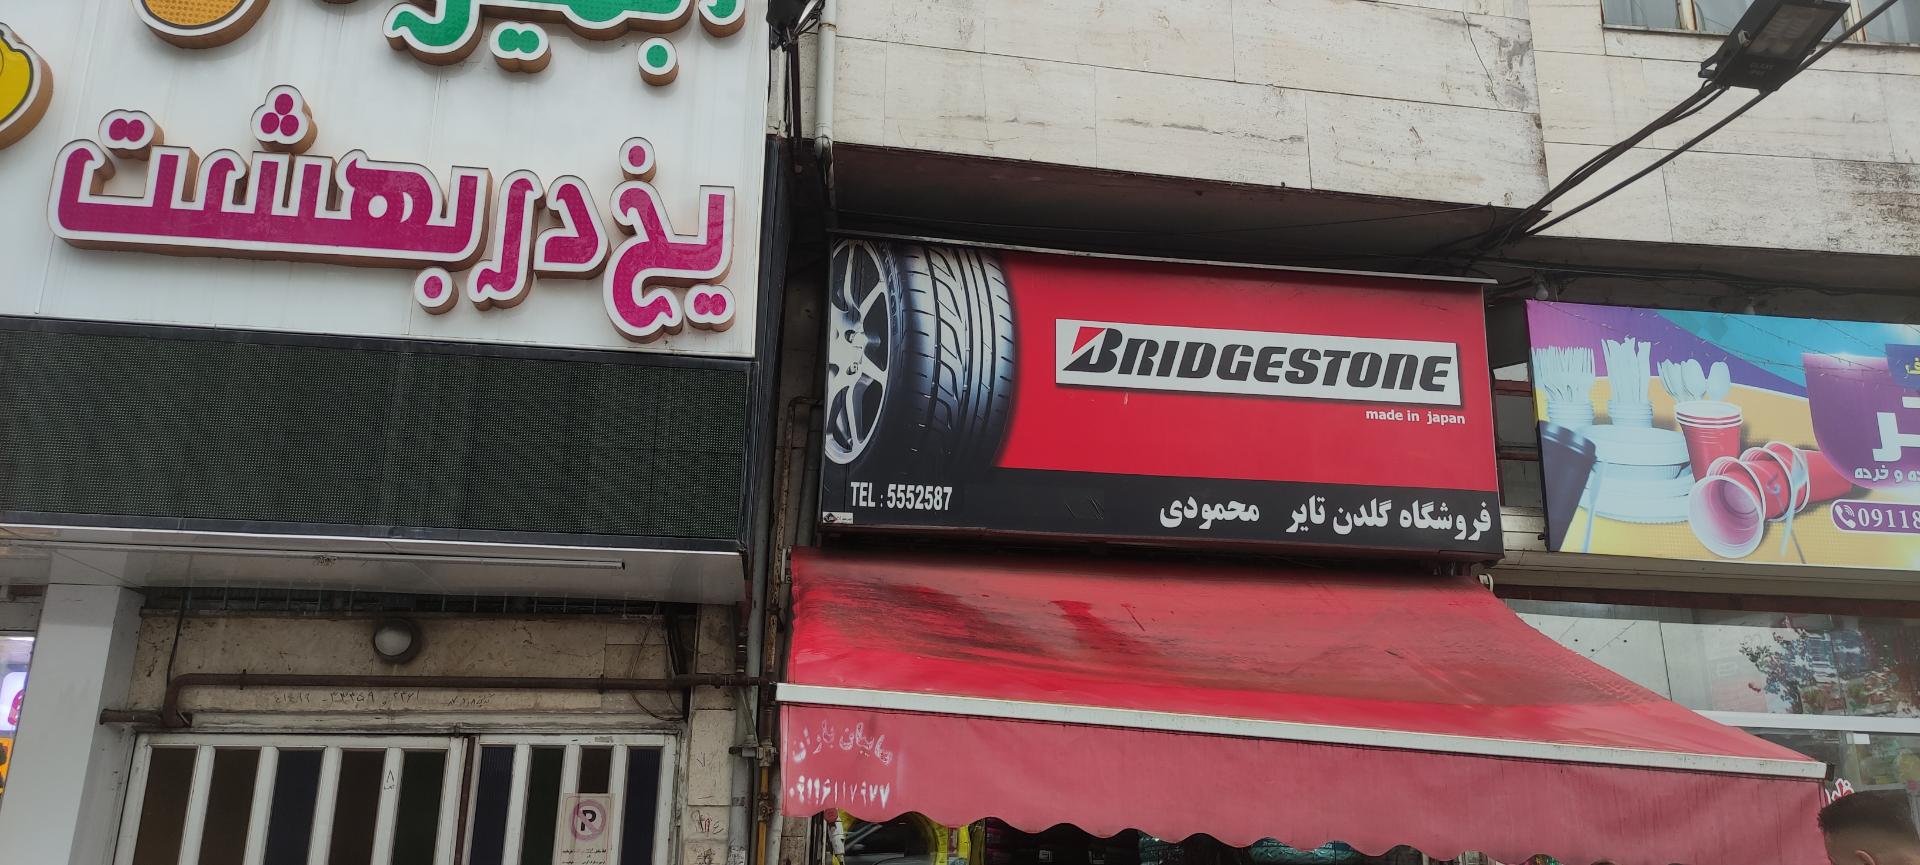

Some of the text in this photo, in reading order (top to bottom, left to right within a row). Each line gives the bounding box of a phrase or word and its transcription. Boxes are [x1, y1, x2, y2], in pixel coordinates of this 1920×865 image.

[48, 85, 736, 340] یخ در بهشت
[1062, 327, 1453, 393] BRIDGESTONE
[1365, 409, 1466, 426] made in japan
[850, 481, 876, 508] TEL
[886, 483, 953, 511] 5552587
[1159, 495, 1492, 541] فروشگاه گلدن تایر محمودی
